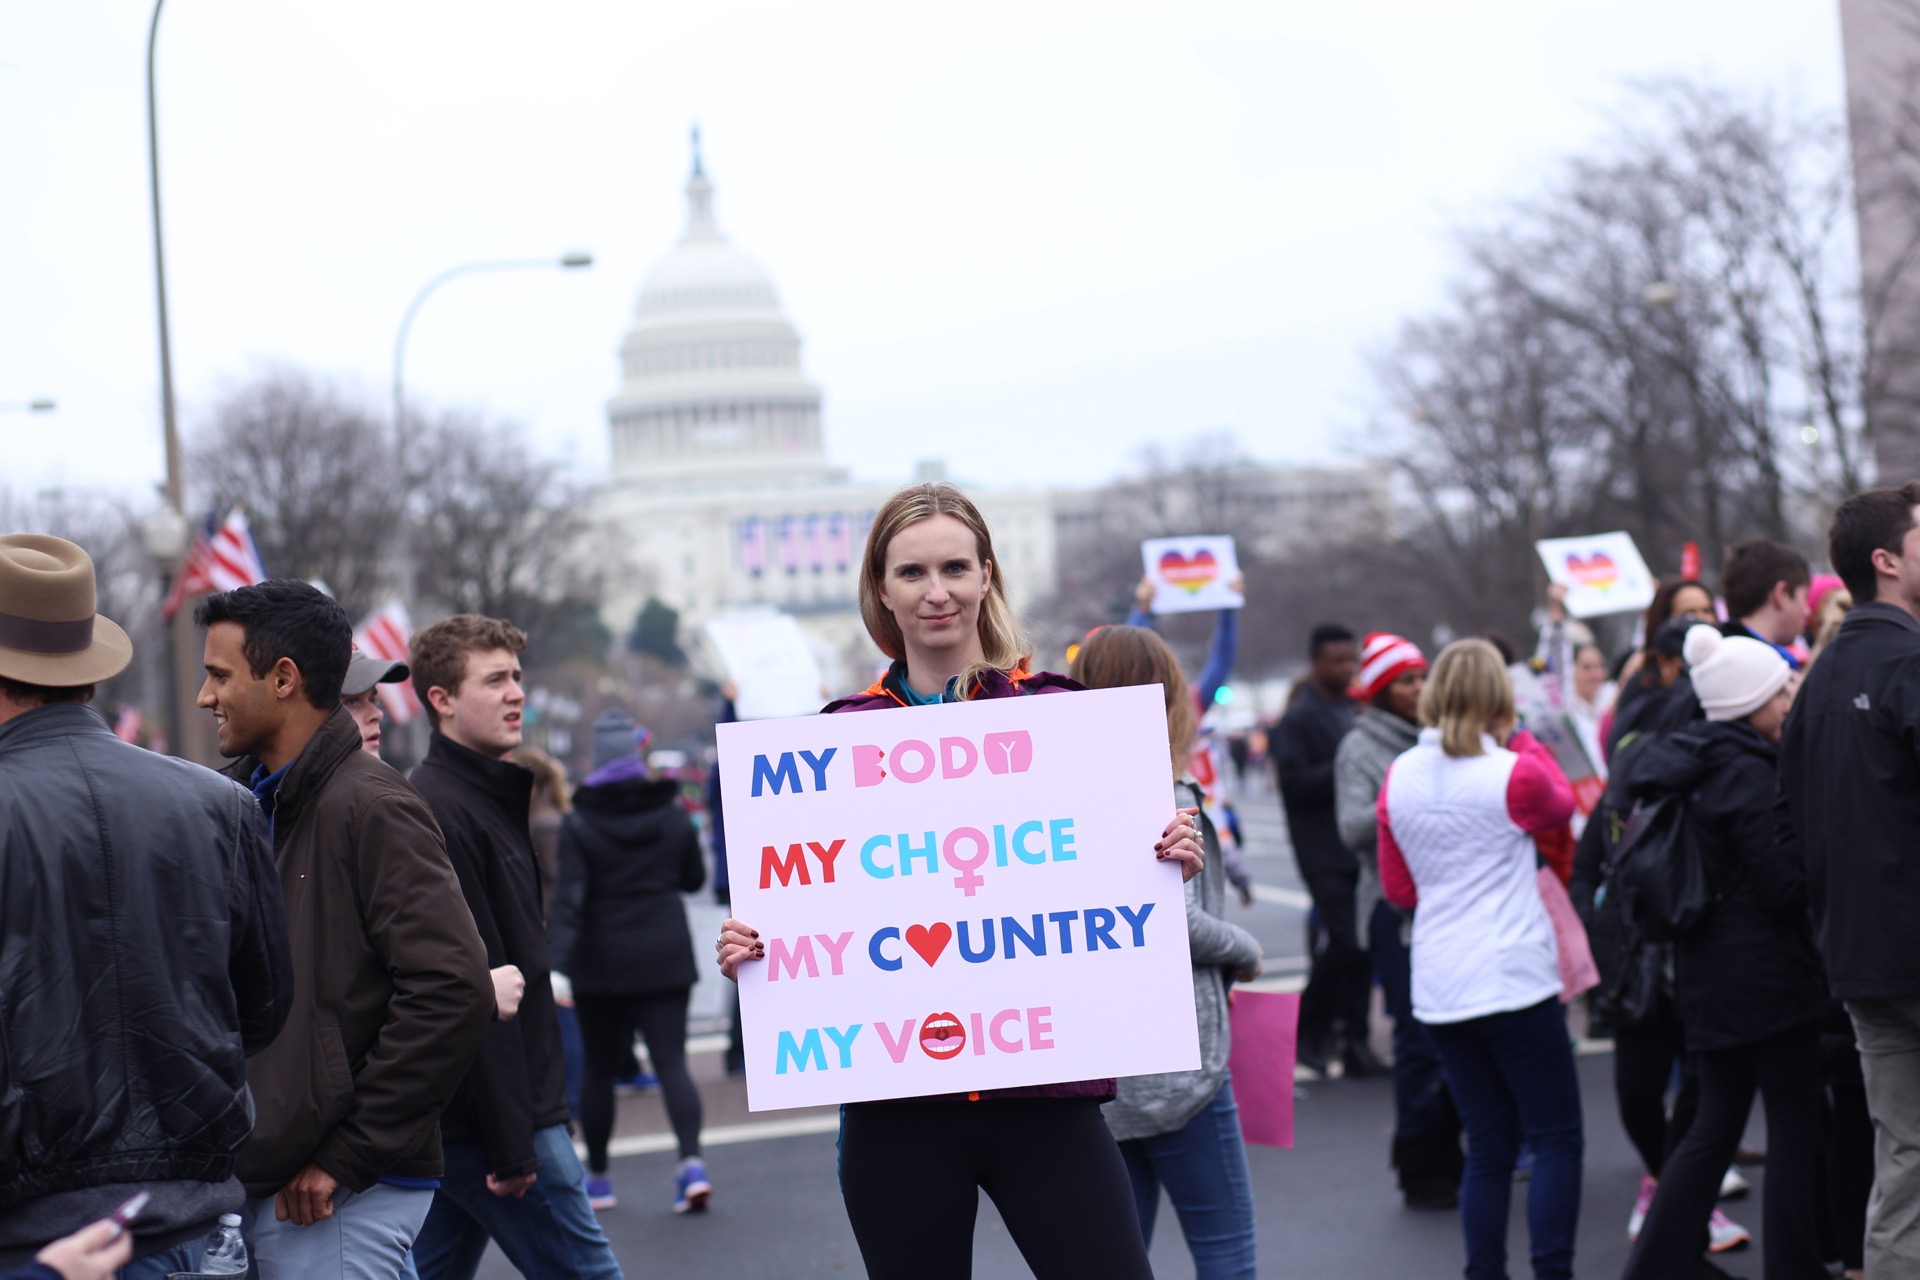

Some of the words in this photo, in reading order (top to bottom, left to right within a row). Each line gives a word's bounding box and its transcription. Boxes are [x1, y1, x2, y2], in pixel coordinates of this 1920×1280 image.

[751, 747, 838, 797] MY
[852, 730, 1033, 788] BODY
[758, 839, 846, 889] MY
[860, 818, 1077, 897] CHOICE
[767, 931, 854, 982] MY
[775, 1024, 862, 1075] MY
[873, 1006, 1055, 1064] VOICE
